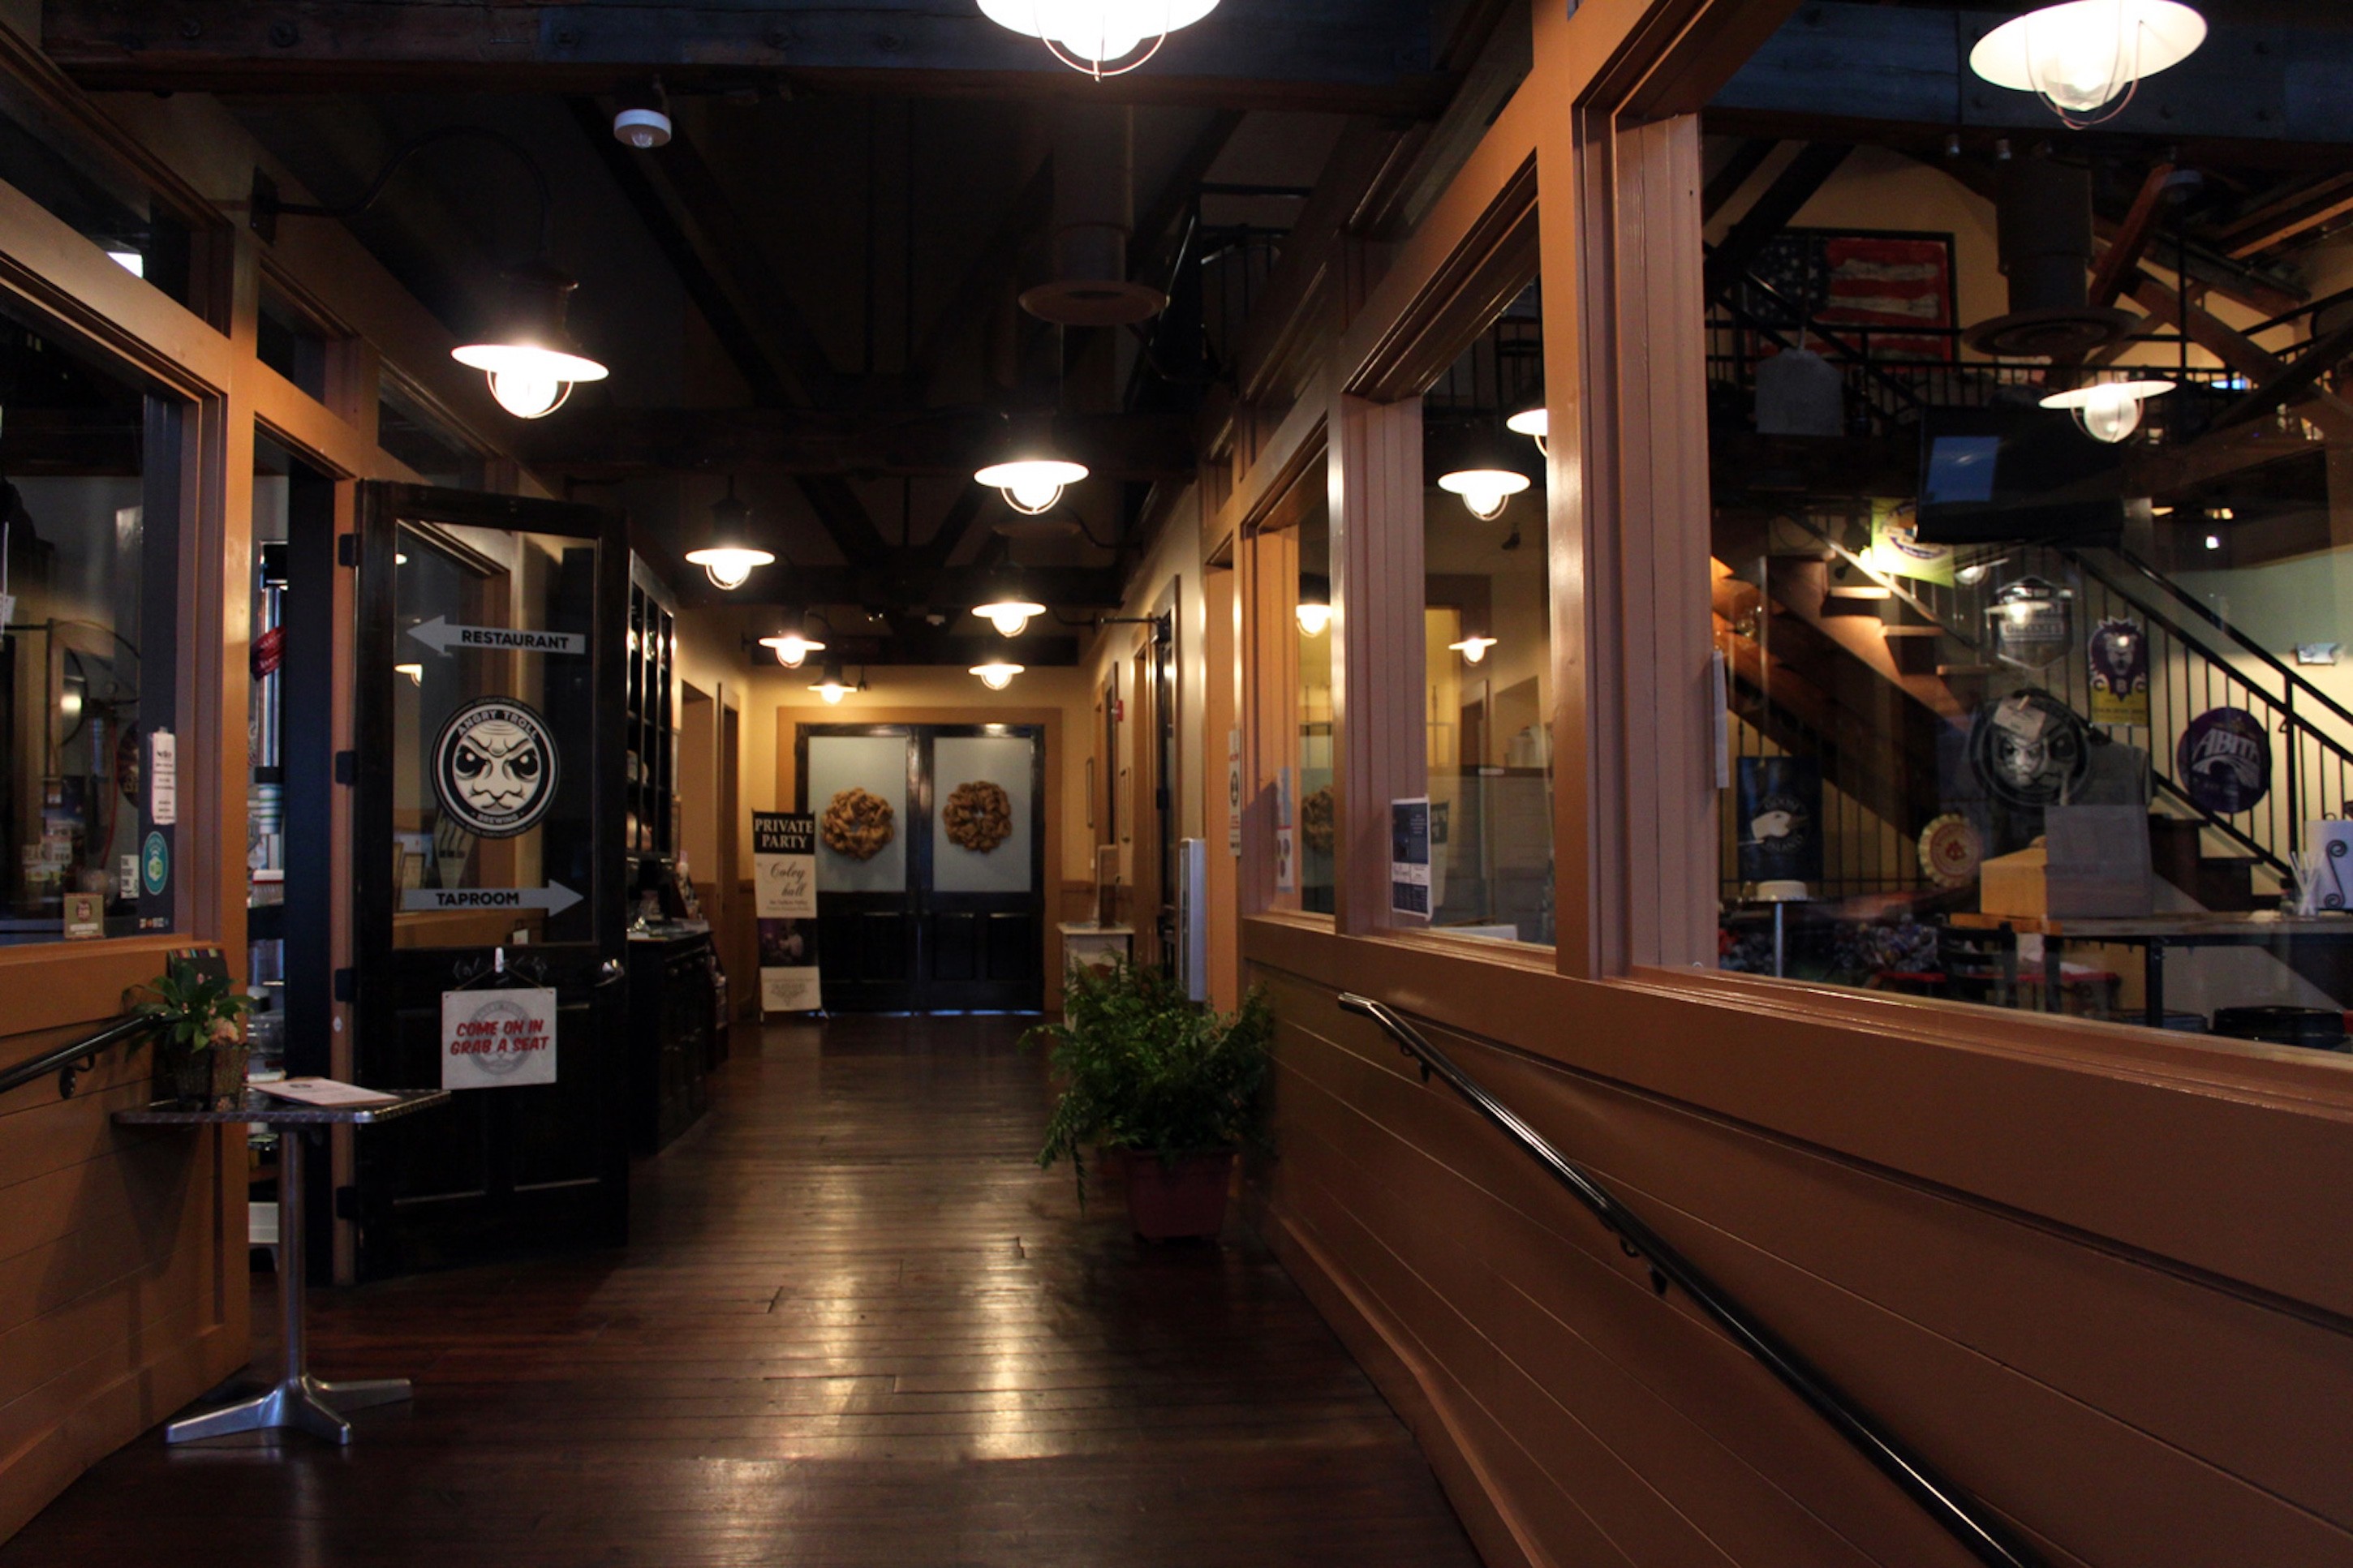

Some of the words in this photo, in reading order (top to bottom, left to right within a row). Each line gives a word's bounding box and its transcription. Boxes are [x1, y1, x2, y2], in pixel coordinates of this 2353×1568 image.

[461, 629, 570, 650] RESTAURANT
[457, 710, 497, 736] ANGRY
[503, 711, 539, 740] TROLL
[476, 813, 519, 824] BREWING
[754, 817, 814, 834] PRIVATE
[761, 833, 807, 849] PARTY
[436, 892, 520, 905] TAPROOM
[456, 1020, 499, 1037] COME
[503, 1020, 525, 1034] ON
[527, 1019, 544, 1033] IN
[450, 1040, 493, 1055] GRAB
[496, 1038, 508, 1053] A
[513, 1035, 550, 1052] SEAT
